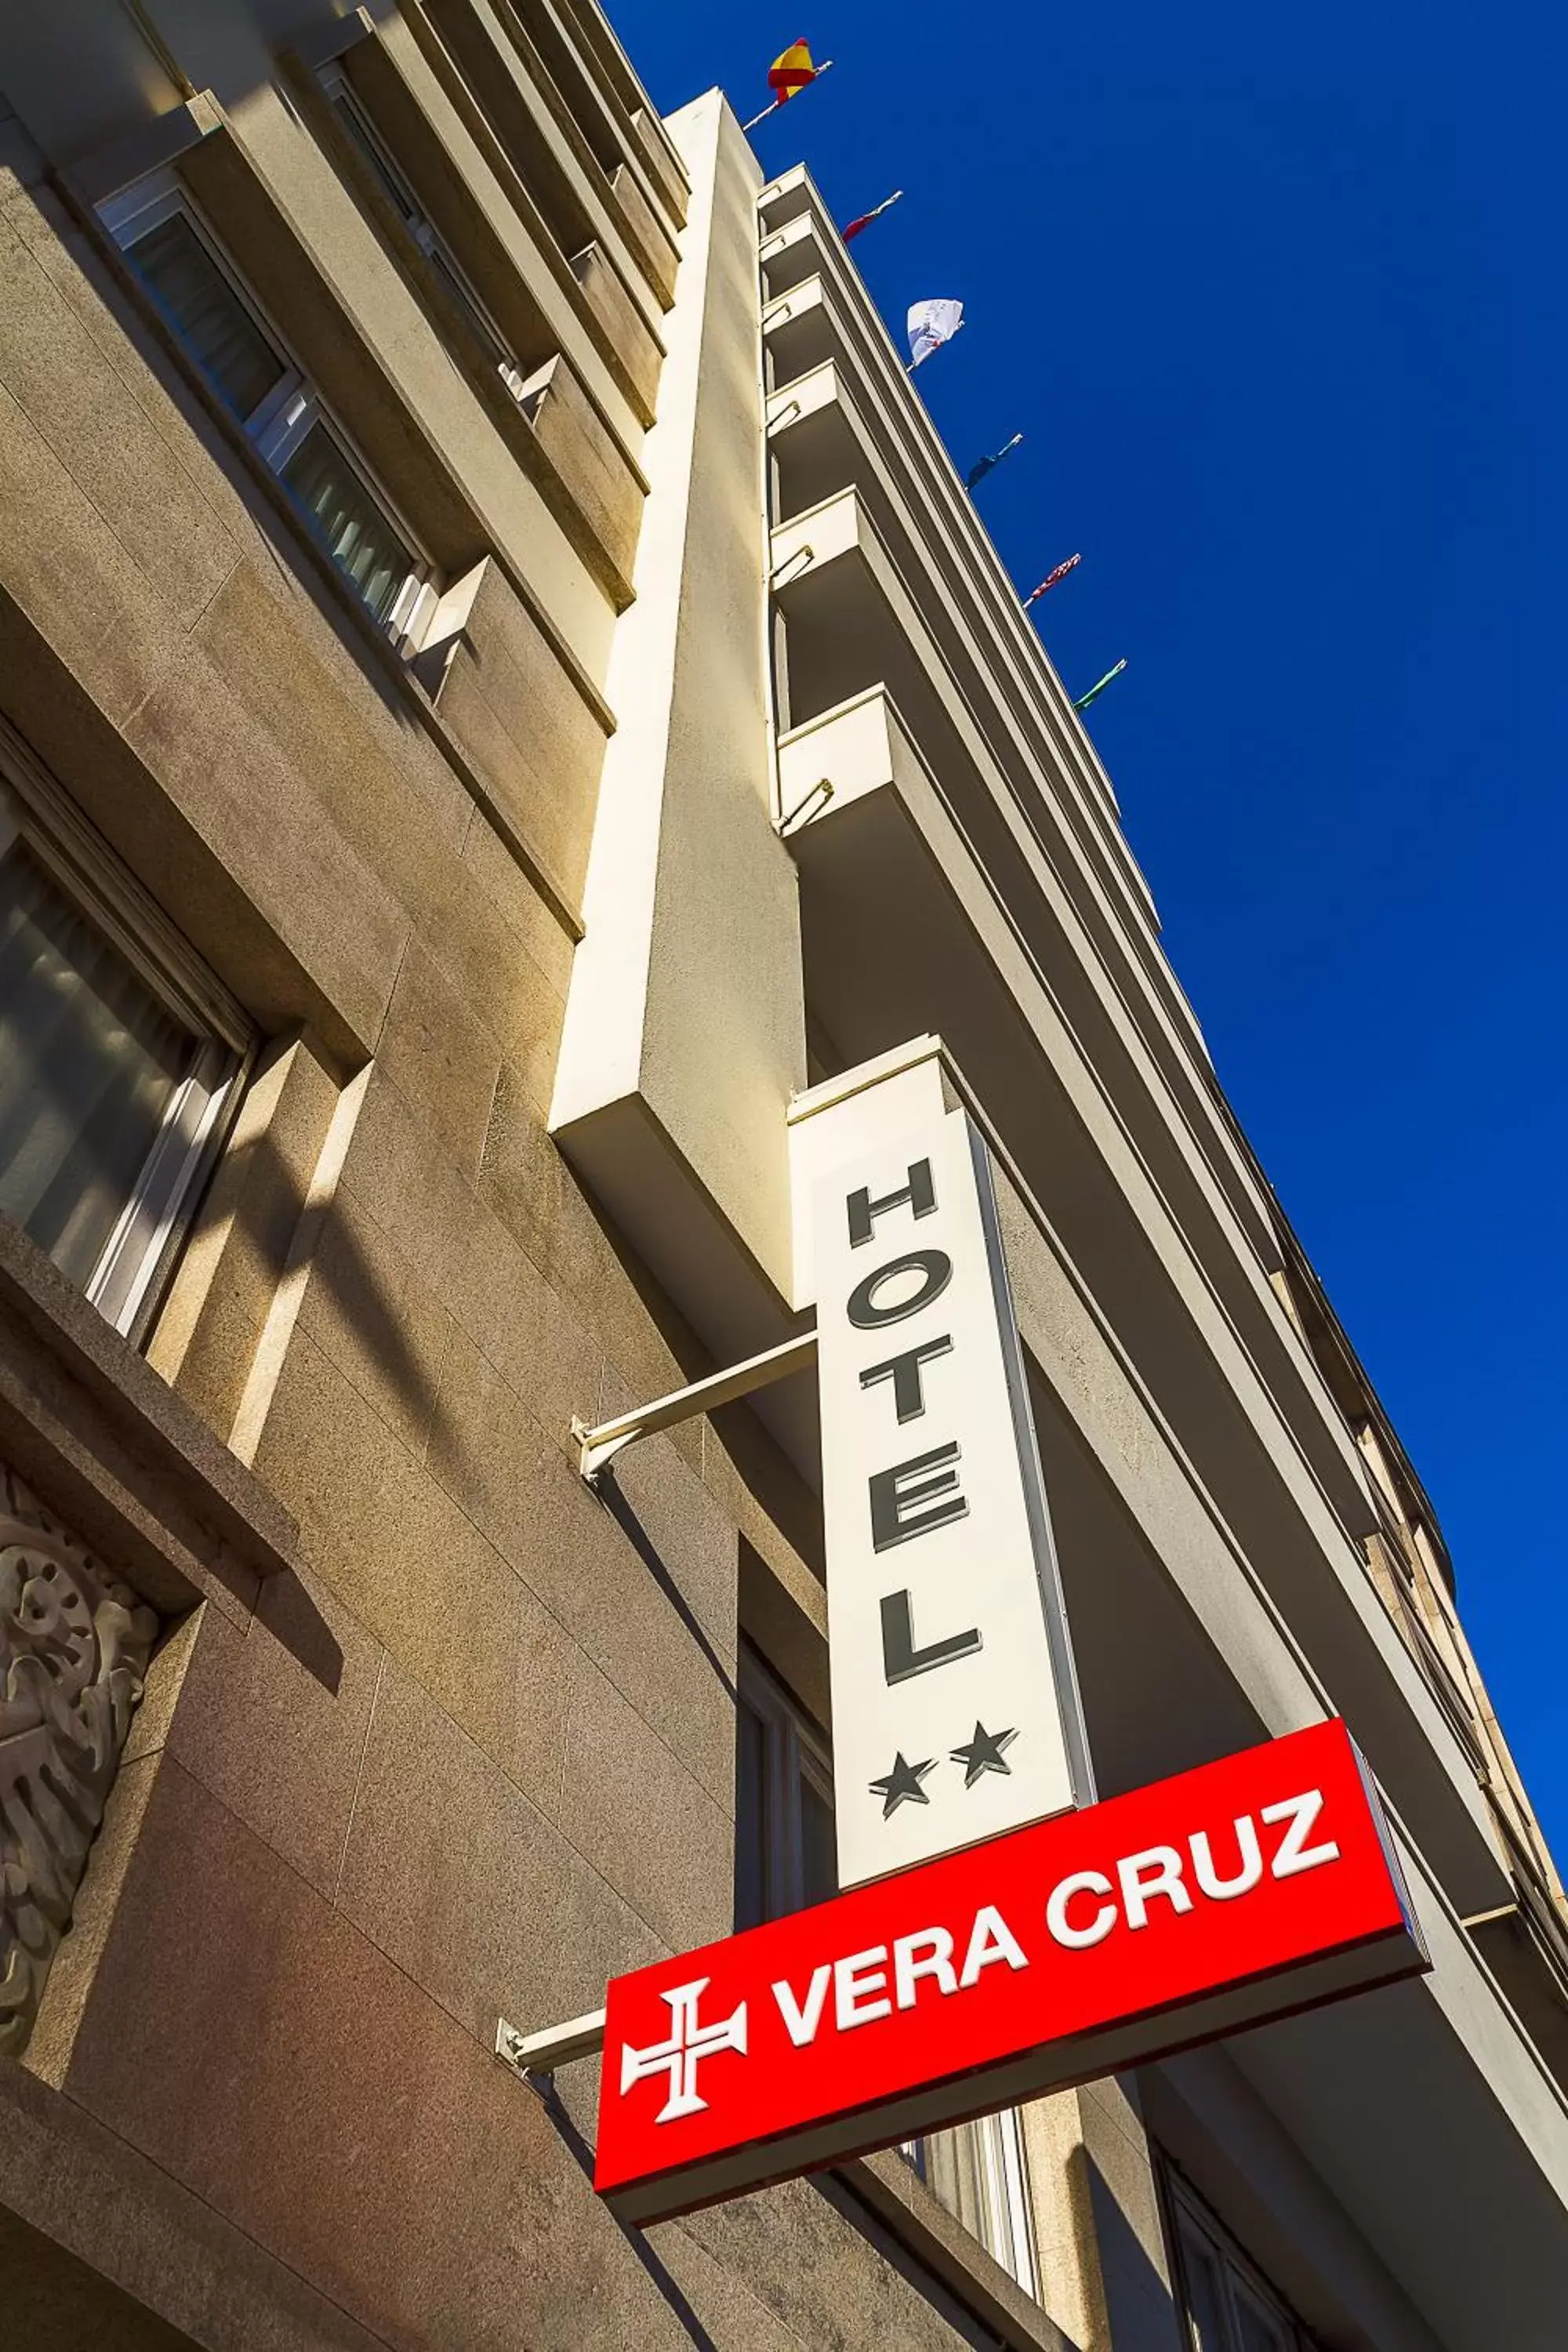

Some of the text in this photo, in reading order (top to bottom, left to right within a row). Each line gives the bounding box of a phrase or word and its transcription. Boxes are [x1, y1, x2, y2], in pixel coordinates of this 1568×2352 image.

[847, 1157, 983, 1687] HOTEL
[770, 1788, 1340, 2047] VERA CRUZ
